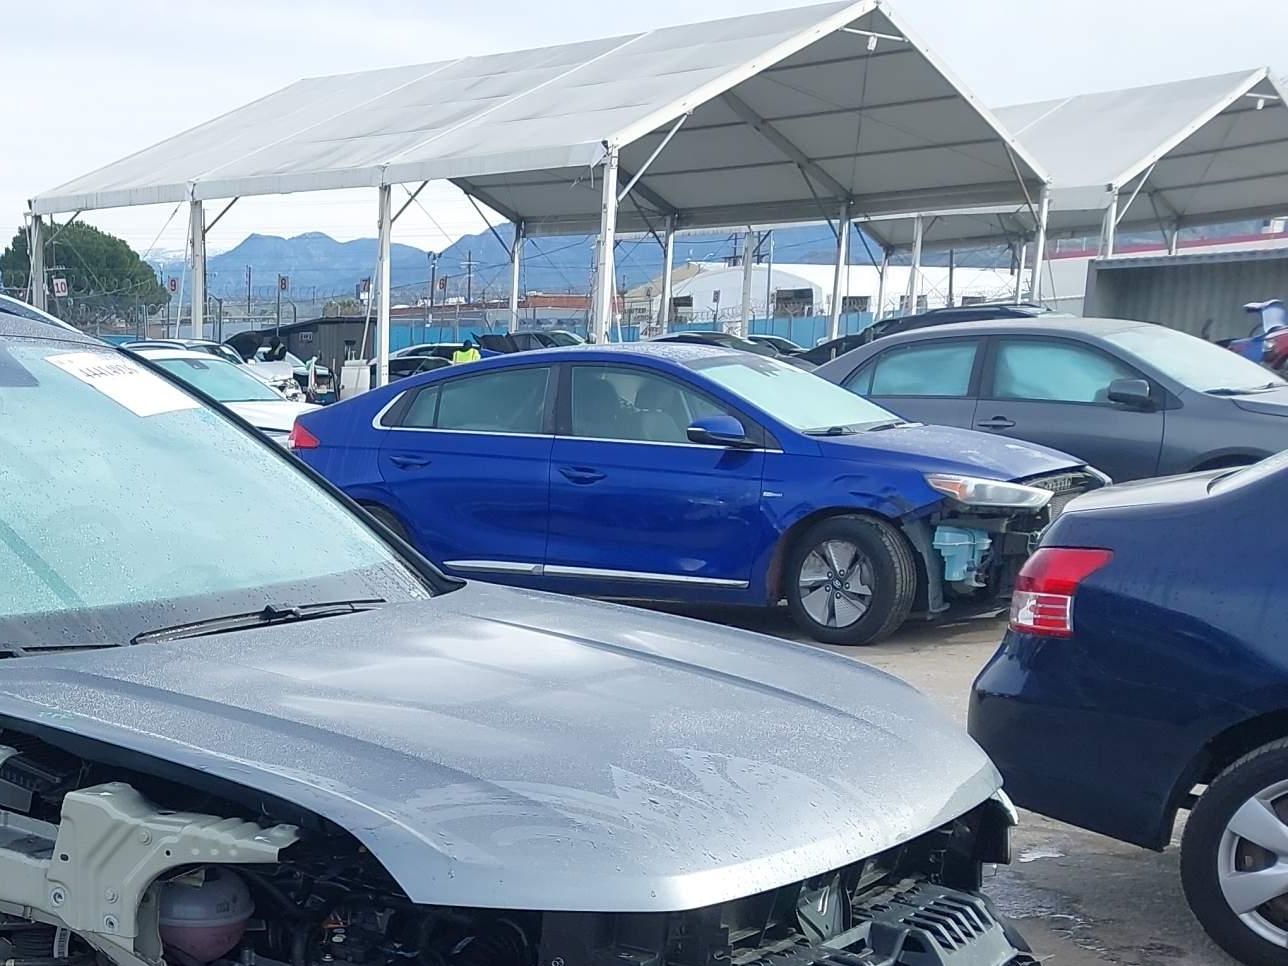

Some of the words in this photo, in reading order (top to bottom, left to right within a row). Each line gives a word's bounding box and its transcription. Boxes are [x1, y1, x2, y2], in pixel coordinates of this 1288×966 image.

[54, 281, 67, 293] 10
[170, 279, 177, 291] 9
[280, 278, 287, 290] 8
